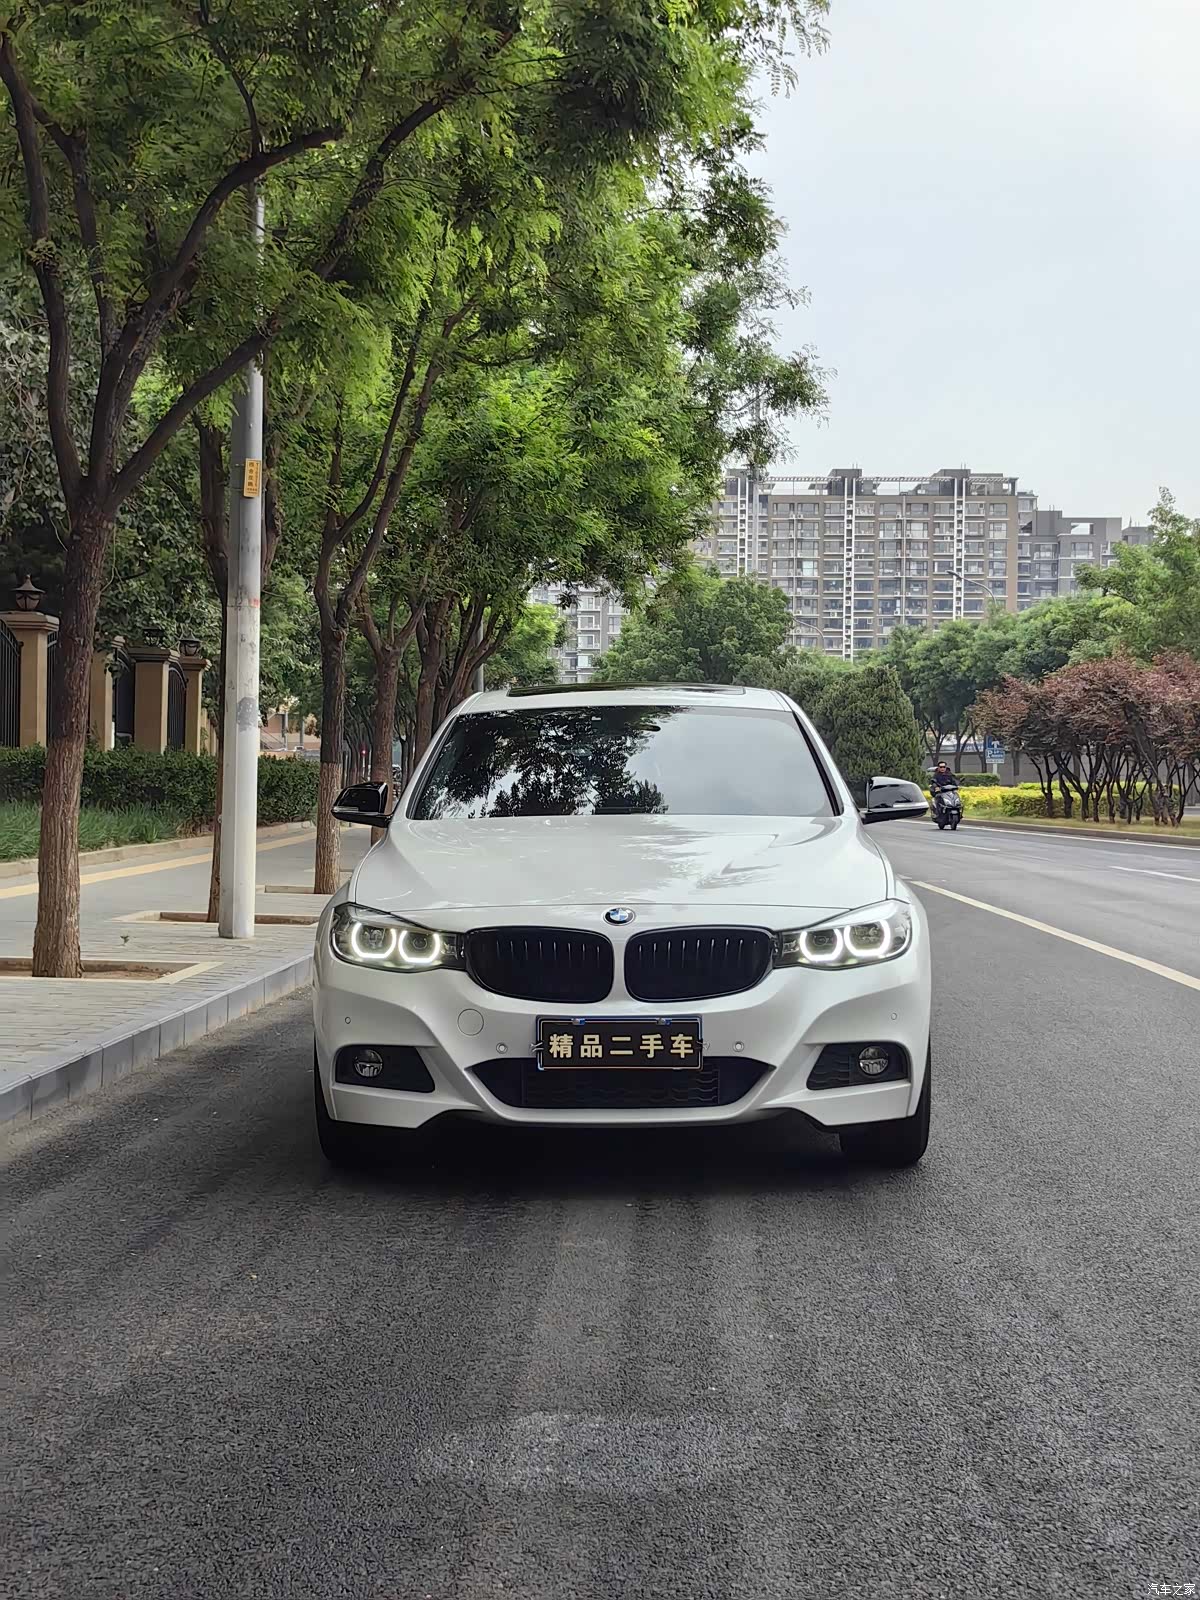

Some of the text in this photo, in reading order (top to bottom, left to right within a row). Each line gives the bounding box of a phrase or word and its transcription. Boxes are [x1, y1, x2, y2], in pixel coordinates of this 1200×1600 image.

[549, 1033, 694, 1059] 精品二手车
